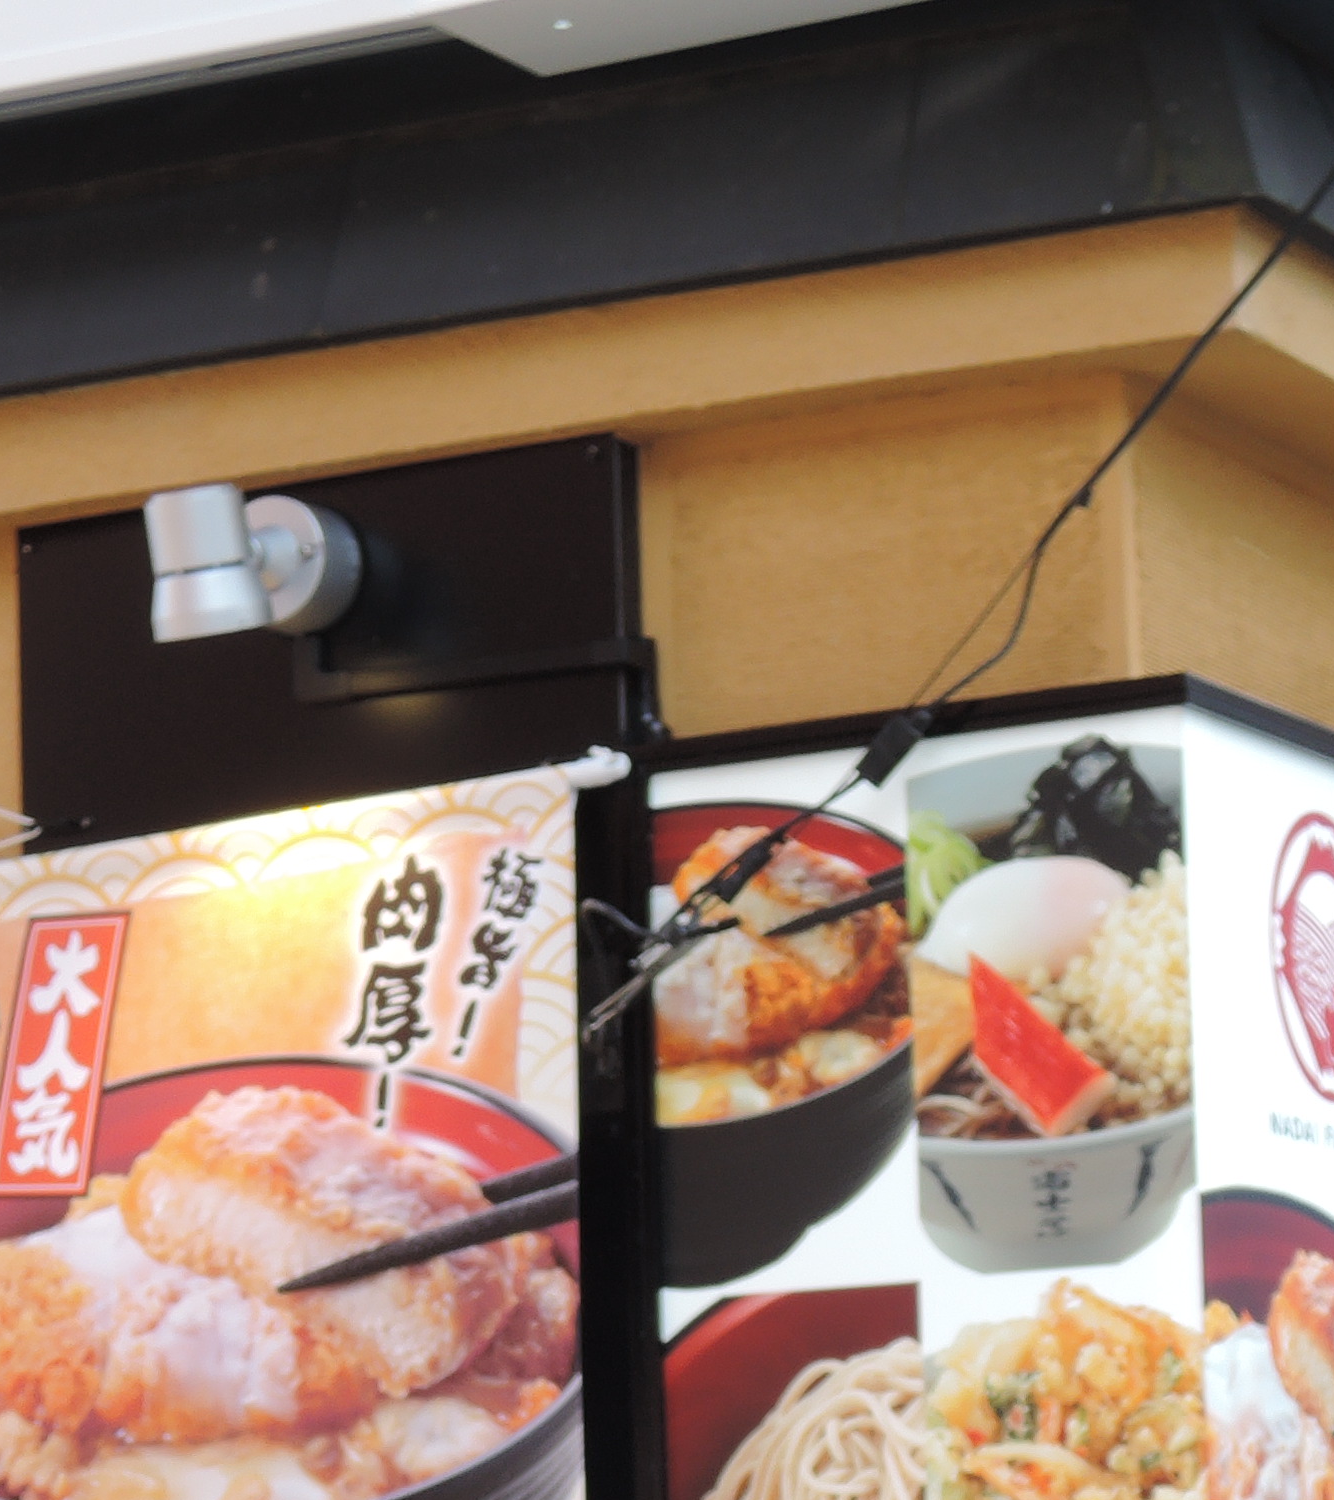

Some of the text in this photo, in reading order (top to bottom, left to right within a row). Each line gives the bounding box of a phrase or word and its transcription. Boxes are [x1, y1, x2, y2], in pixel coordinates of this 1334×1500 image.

[7, 930, 101, 1178] 大人気
[342, 853, 444, 1129] 肉厚！
